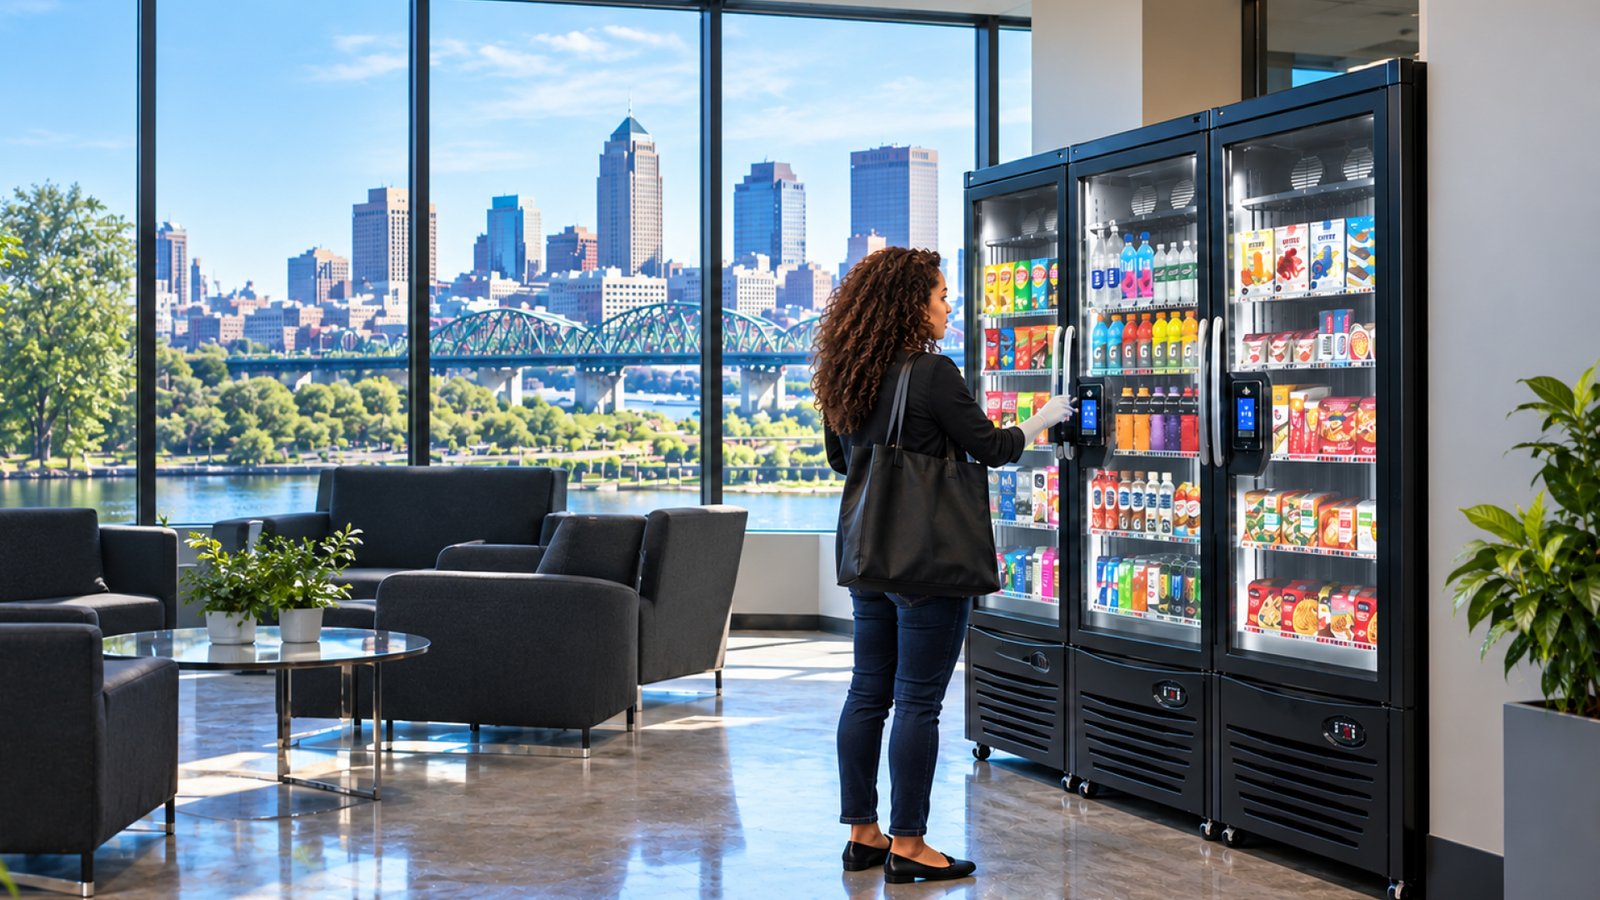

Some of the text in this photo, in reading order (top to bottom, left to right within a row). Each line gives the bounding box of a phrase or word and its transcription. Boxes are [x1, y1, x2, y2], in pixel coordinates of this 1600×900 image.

[1094, 347, 1101, 359] G
[1109, 345, 1116, 358] G
[1125, 345, 1131, 358] G
[1140, 345, 1147, 358] G
[1155, 345, 1161, 357] G
[1170, 344, 1176, 357] G
[1184, 344, 1191, 357] G
